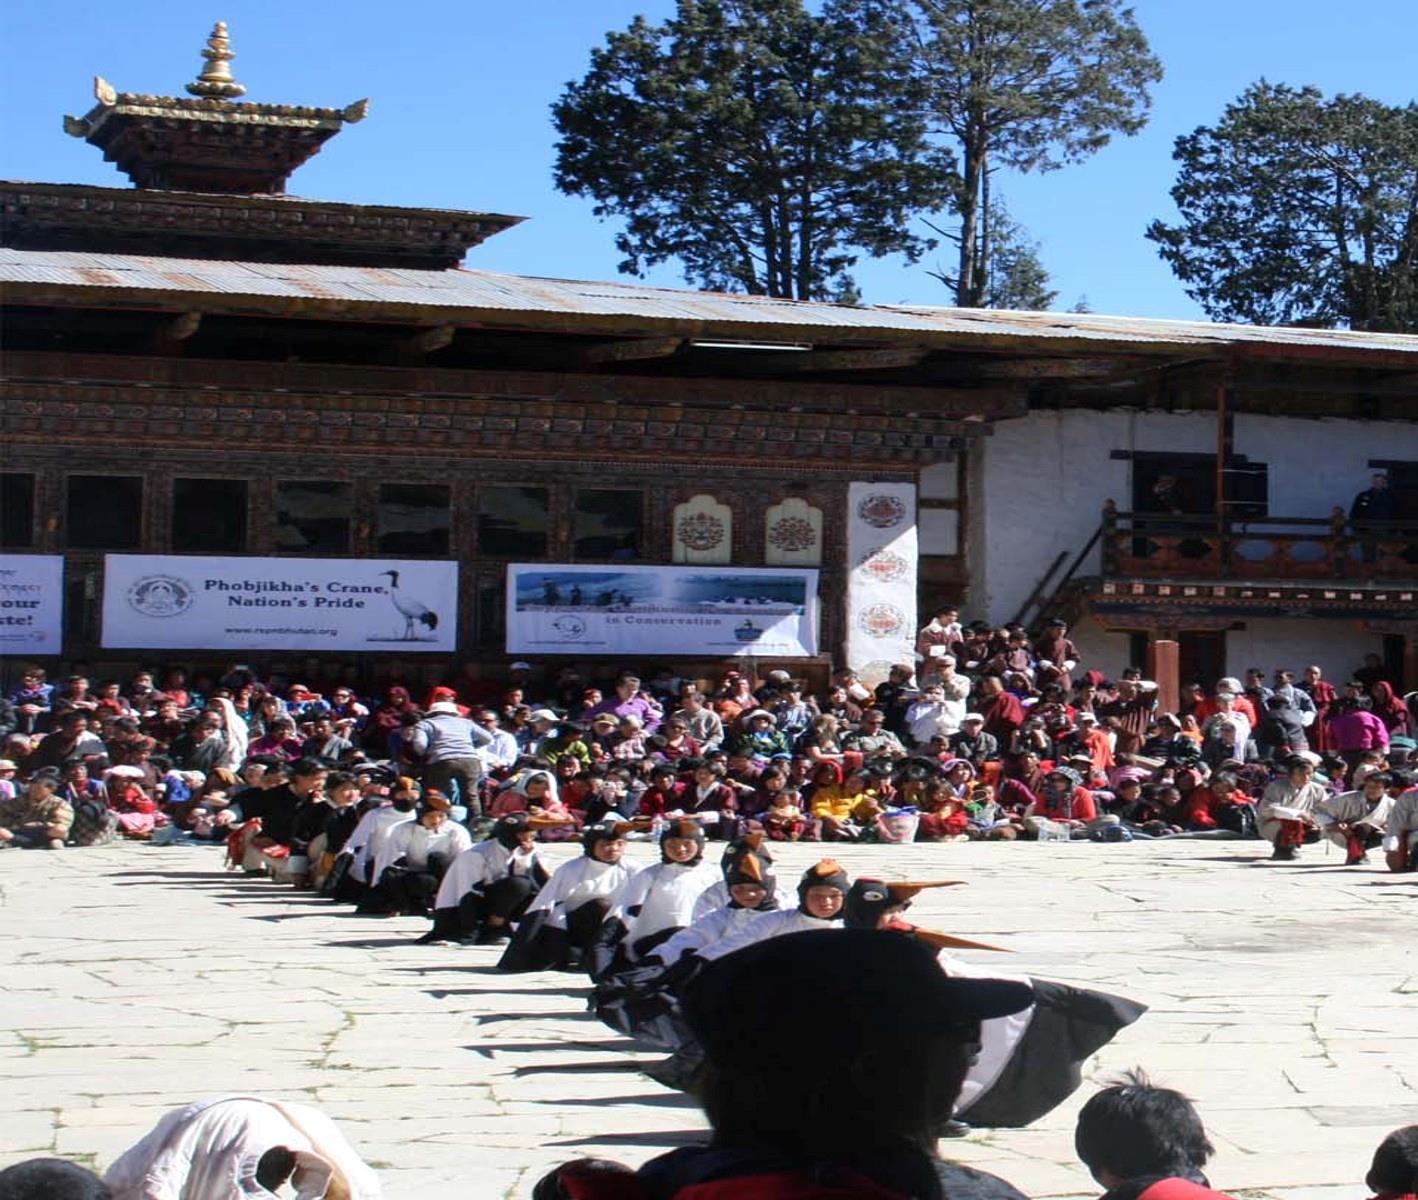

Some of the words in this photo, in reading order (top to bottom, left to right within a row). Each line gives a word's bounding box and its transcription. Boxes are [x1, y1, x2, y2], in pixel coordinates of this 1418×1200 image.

[204, 579, 320, 594] Phobjikha's
[326, 582, 389, 594] Crane,
[228, 595, 307, 608] Nation's
[314, 596, 366, 608] Pride
[606, 615, 620, 624] in
[624, 615, 722, 625] Conservation
